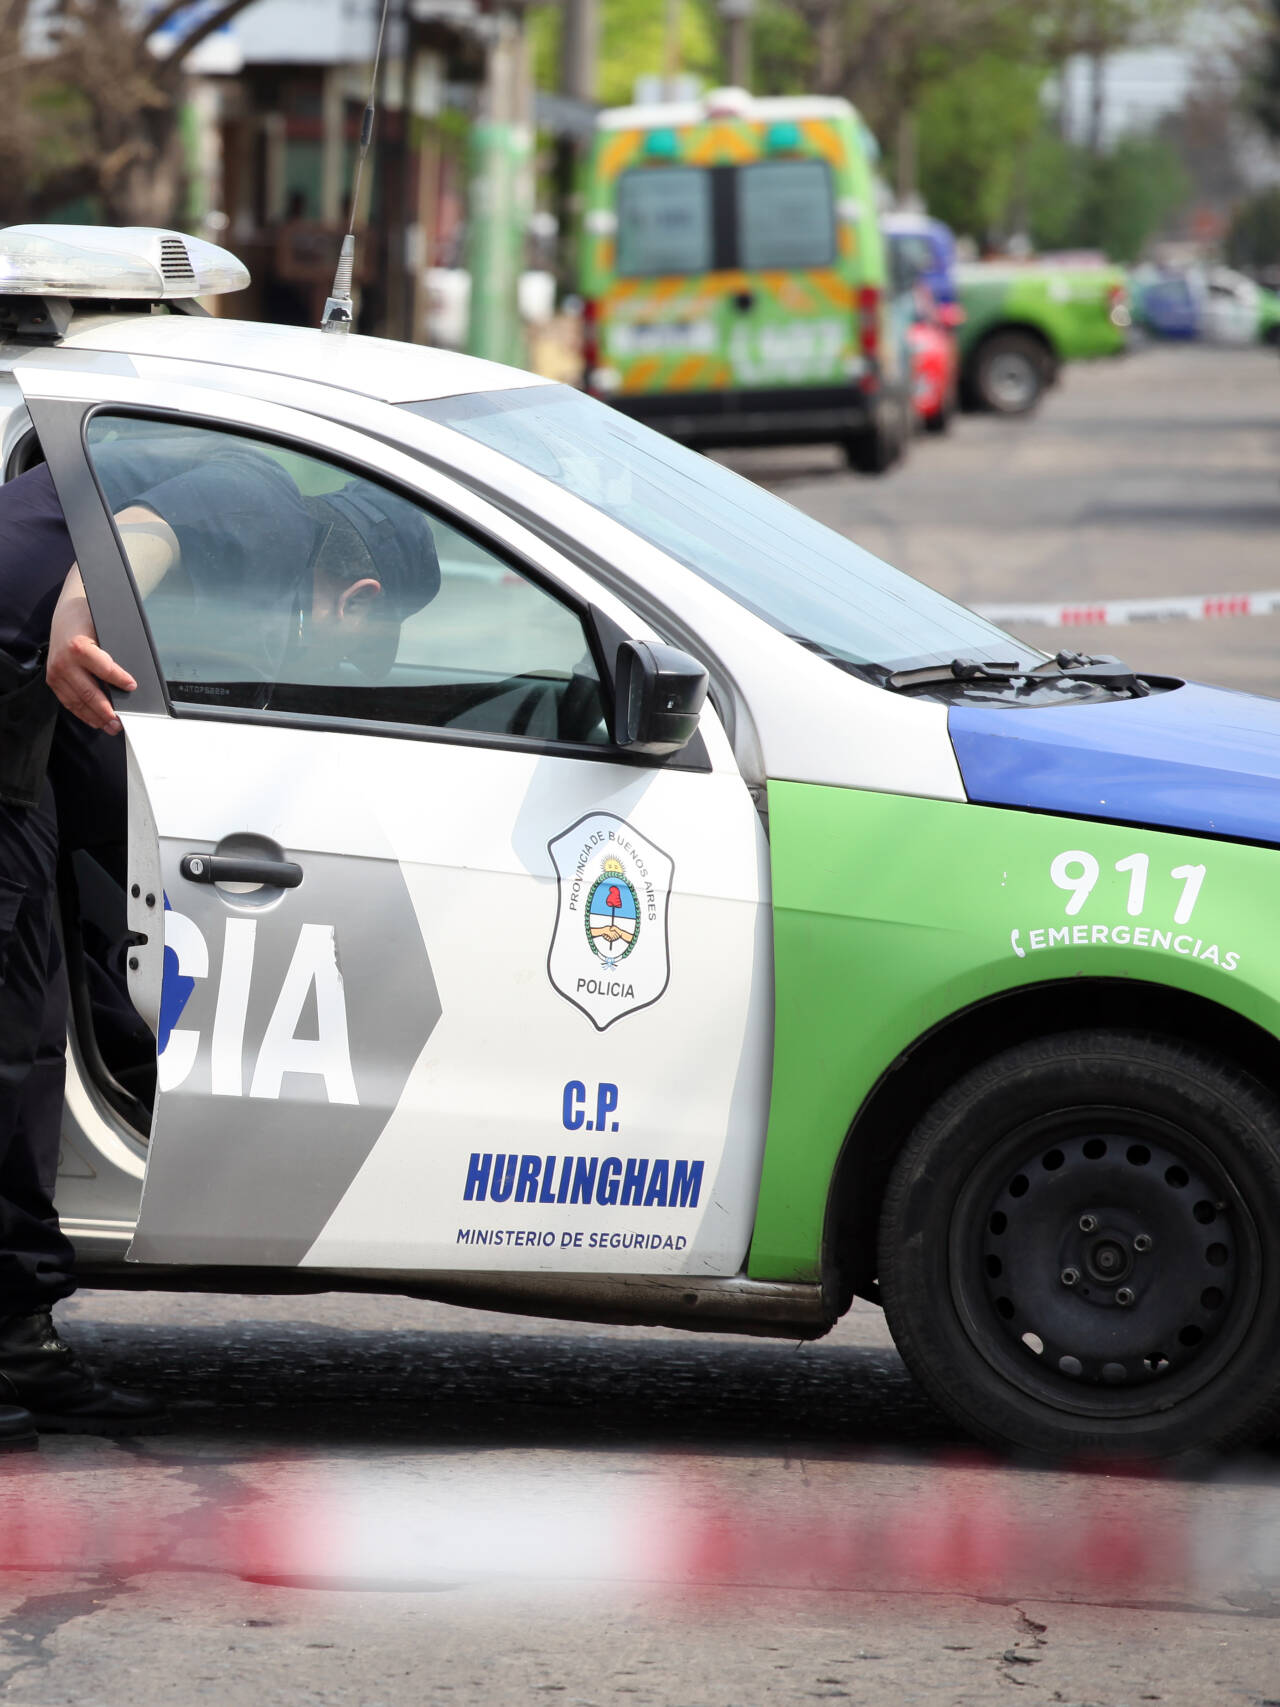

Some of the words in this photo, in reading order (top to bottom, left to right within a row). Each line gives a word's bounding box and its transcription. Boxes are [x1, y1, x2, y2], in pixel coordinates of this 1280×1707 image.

[569, 844, 593, 911] PROVINCIA
[589, 830, 606, 845] DE
[607, 830, 649, 878] BUENOS
[644, 880, 657, 921] AIRES
[1050, 850, 1207, 925] 911
[1029, 925, 1241, 971] EMERGENCIAS
[576, 977, 635, 999] POLICIA
[562, 1080, 620, 1132] C.P.
[463, 1152, 705, 1208] HURLINGHAM
[456, 1228, 556, 1247] MINISTERIO
[560, 1231, 584, 1249] DE
[588, 1232, 687, 1251] SEGURIDAD
